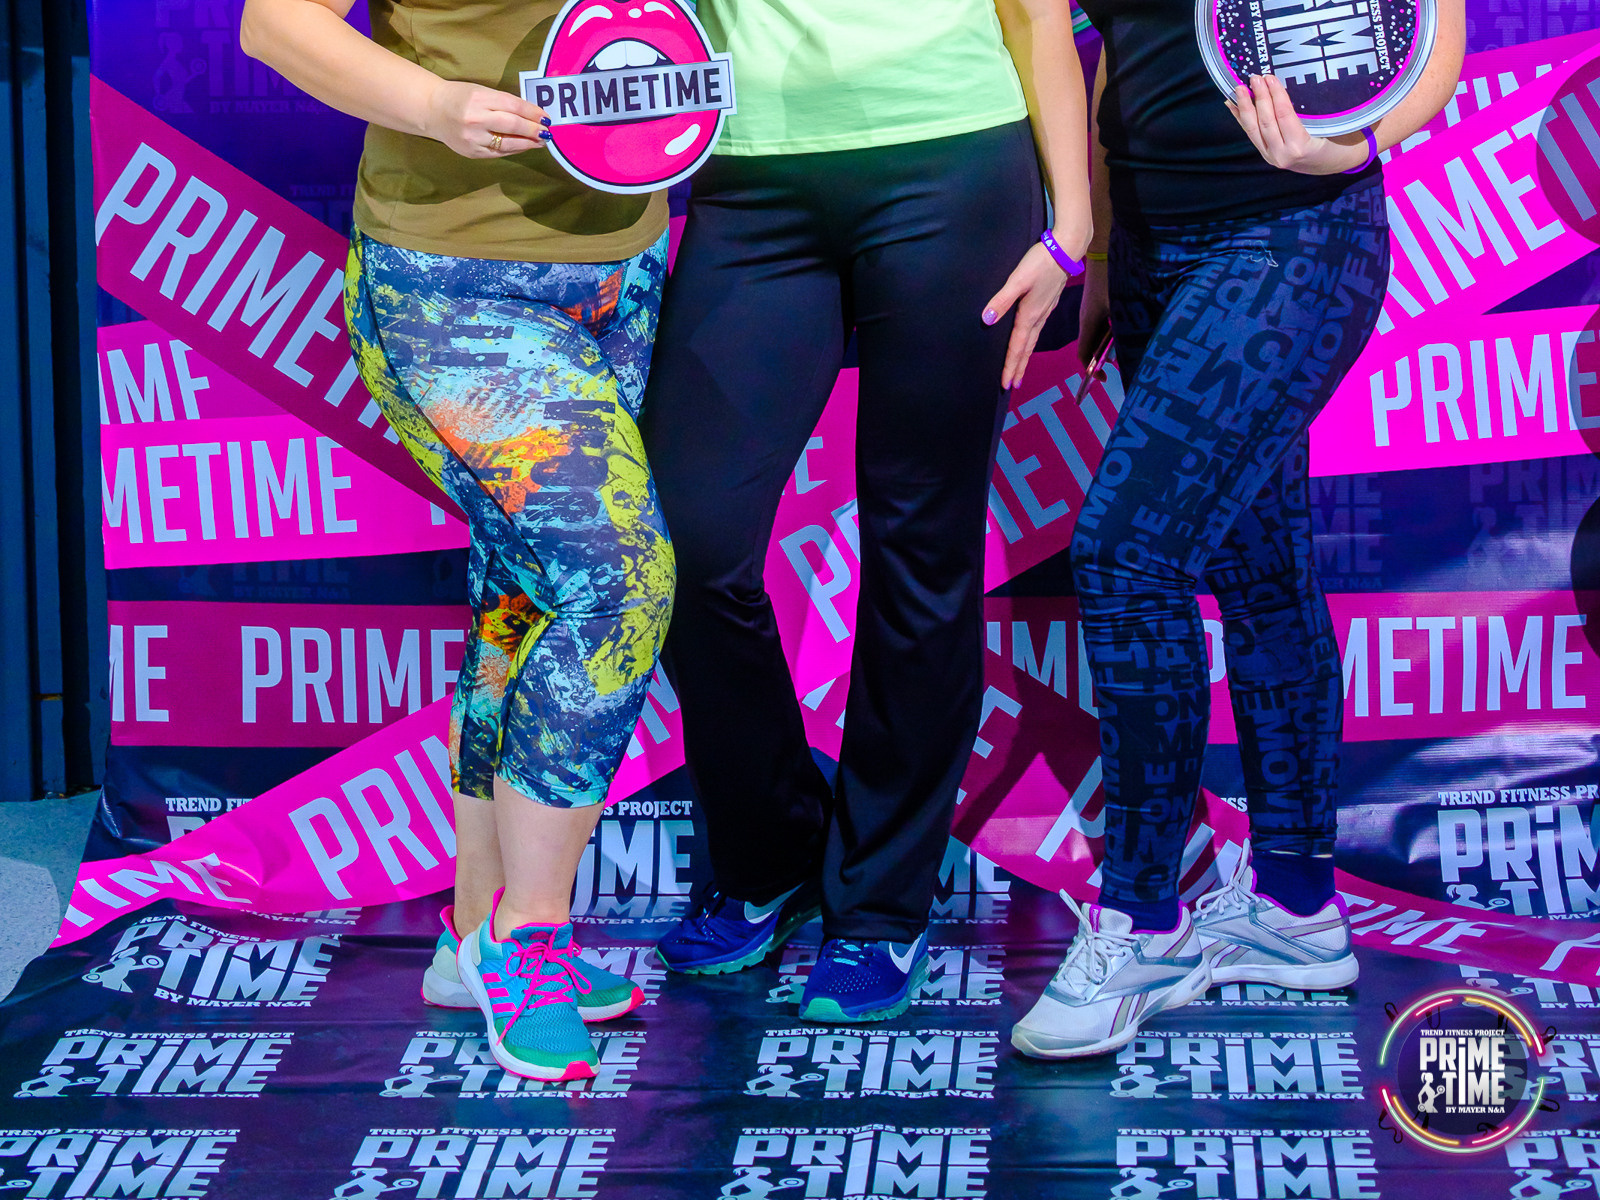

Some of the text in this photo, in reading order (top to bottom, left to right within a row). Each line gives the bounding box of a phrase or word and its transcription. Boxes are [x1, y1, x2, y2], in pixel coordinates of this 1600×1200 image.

[1373, 23, 1391, 70] PROJECT
[536, 68, 723, 119] PRIMETIME
[165, 797, 222, 813] TREND
[1437, 789, 1496, 806] TREND
[1500, 786, 1571, 803] FITNESS
[618, 800, 693, 818] PROJECT
[158, 947, 328, 1001] TIME
[153, 988, 312, 1008] BY MAYER N&A
[65, 1028, 127, 1039] TREND
[211, 1032, 295, 1040] PROJECT
[765, 1028, 999, 1037] TREND FITNESS PROJECT
[1269, 1031, 1354, 1039] PROJECT
[95, 1065, 277, 1093] TIME
[818, 1061, 998, 1091] TIME
[1178, 1065, 1364, 1093] TIME
[458, 1091, 628, 1099] BY MAYER N&A
[823, 1089, 995, 1099] BY MAYER N&A
[66, 1128, 148, 1136] FITNESS
[151, 1129, 241, 1137] PROJECT
[369, 1127, 617, 1137] TREND FITNESS PROJECT
[742, 1123, 992, 1135] TREND FITNESS PROJECT
[1280, 1129, 1370, 1138] PROJECT
[24, 1166, 220, 1199] TIME
[413, 1166, 606, 1199] TIME
[797, 1160, 991, 1198] TIME
[1183, 1167, 1382, 1199] TIME
